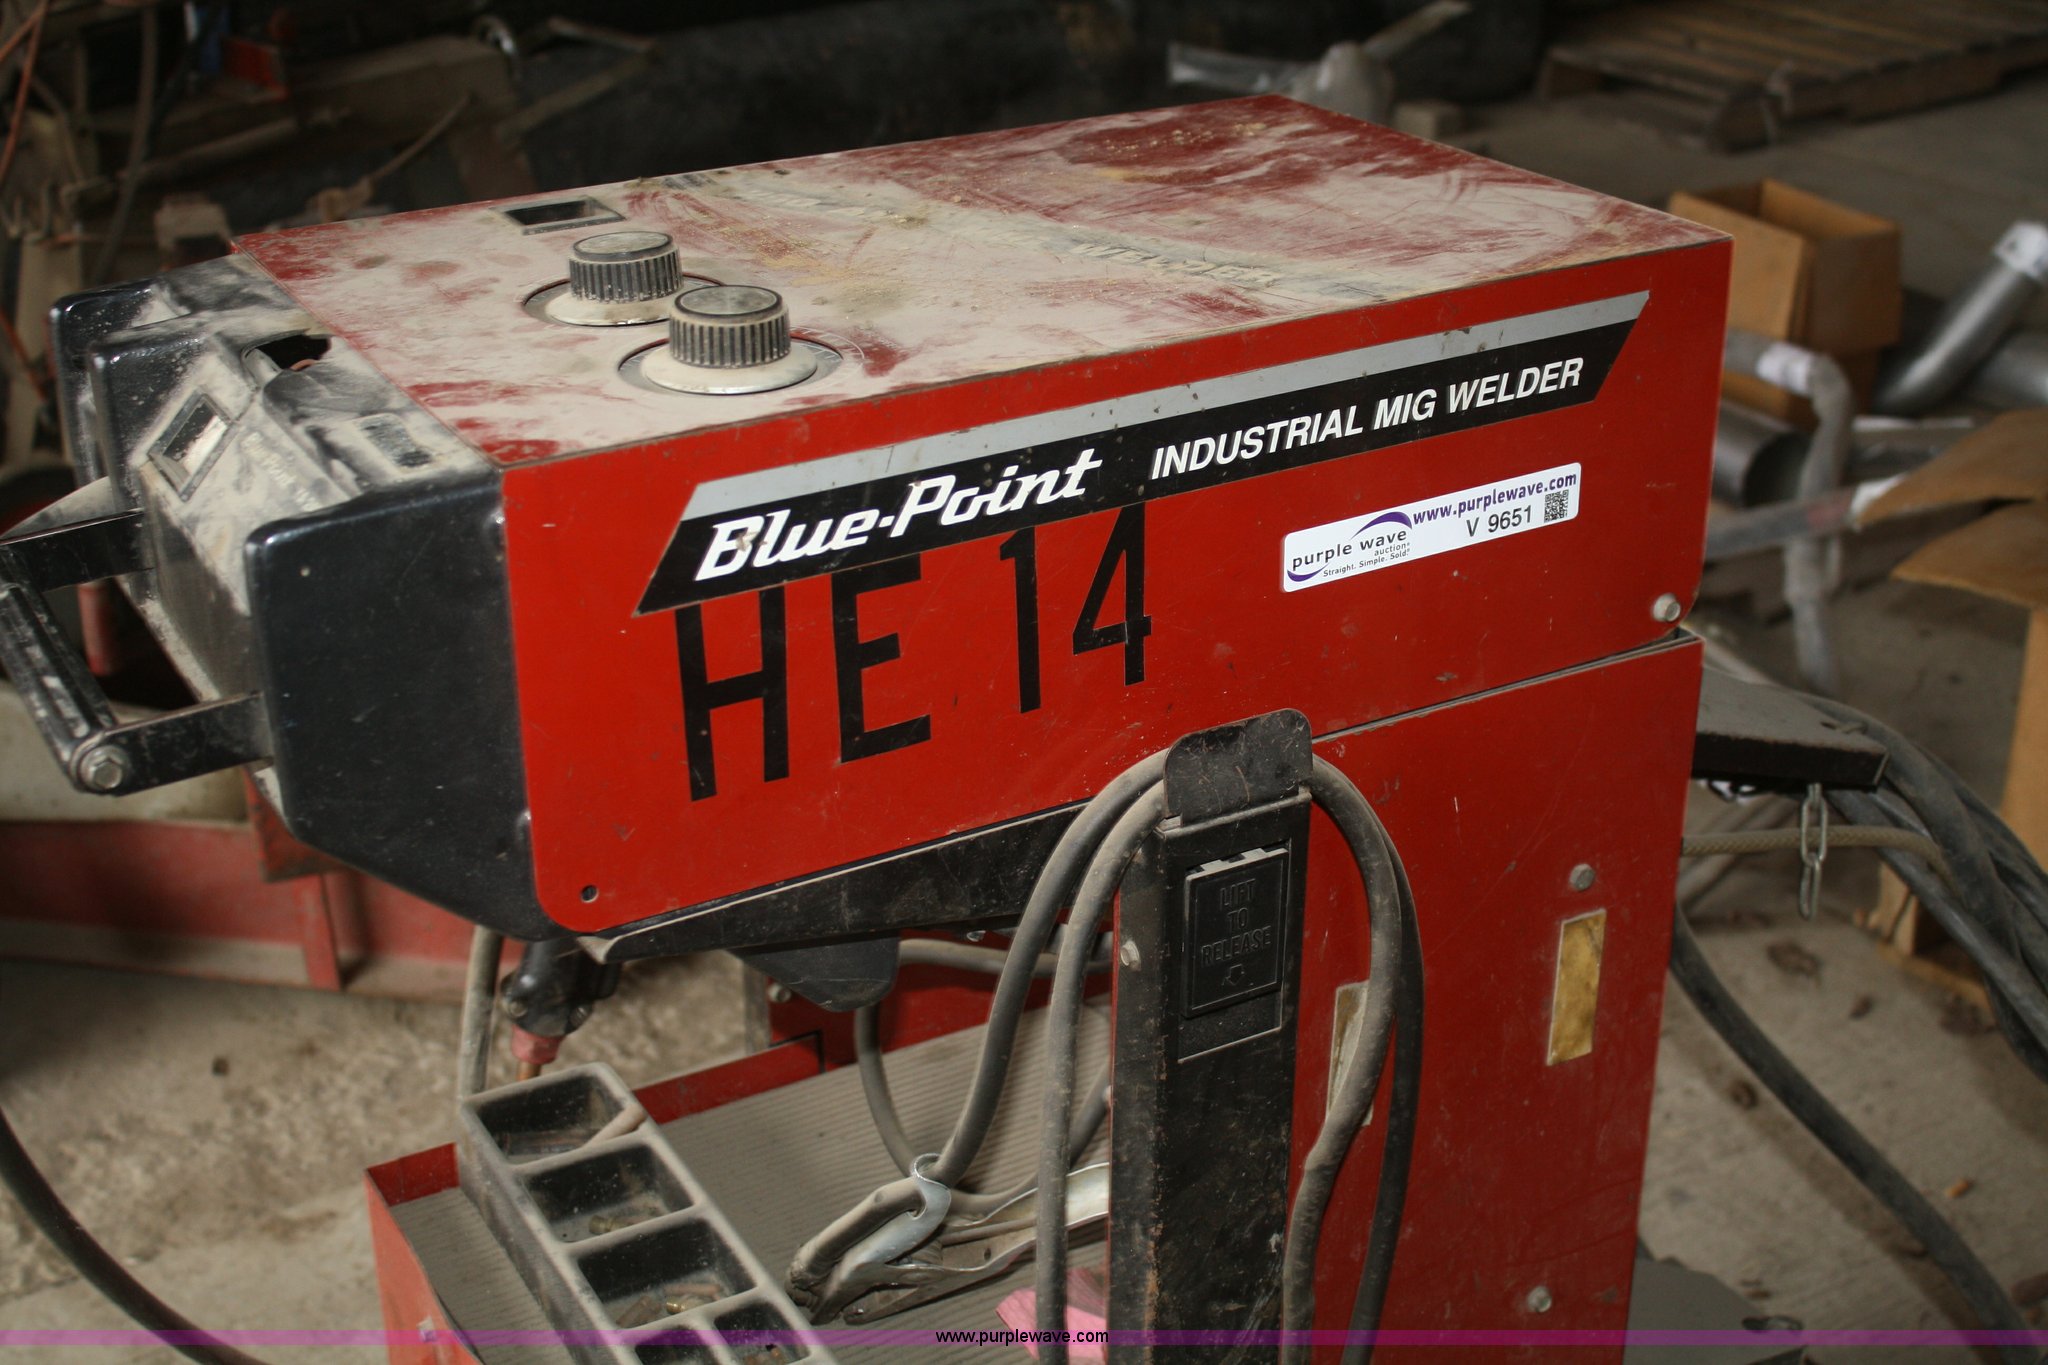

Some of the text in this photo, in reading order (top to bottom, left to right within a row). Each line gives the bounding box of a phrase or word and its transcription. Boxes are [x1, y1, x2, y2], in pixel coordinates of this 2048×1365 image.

[1148, 357, 1584, 481] INDUSTRIAL MIG WELDER
[695, 447, 1103, 582] Blue-Point
[1412, 472, 1578, 526] www.purplewave.com
[1466, 504, 1533, 538] V 9651
[1292, 530, 1407, 572] purple wave
[1323, 563, 1357, 578] Straight.
[1359, 555, 1388, 569] Simple.
[674, 502, 1152, 802] HE 14
[1219, 878, 1256, 911] LIFT
[1226, 907, 1248, 930] TO
[1200, 925, 1272, 966] RELEASE
